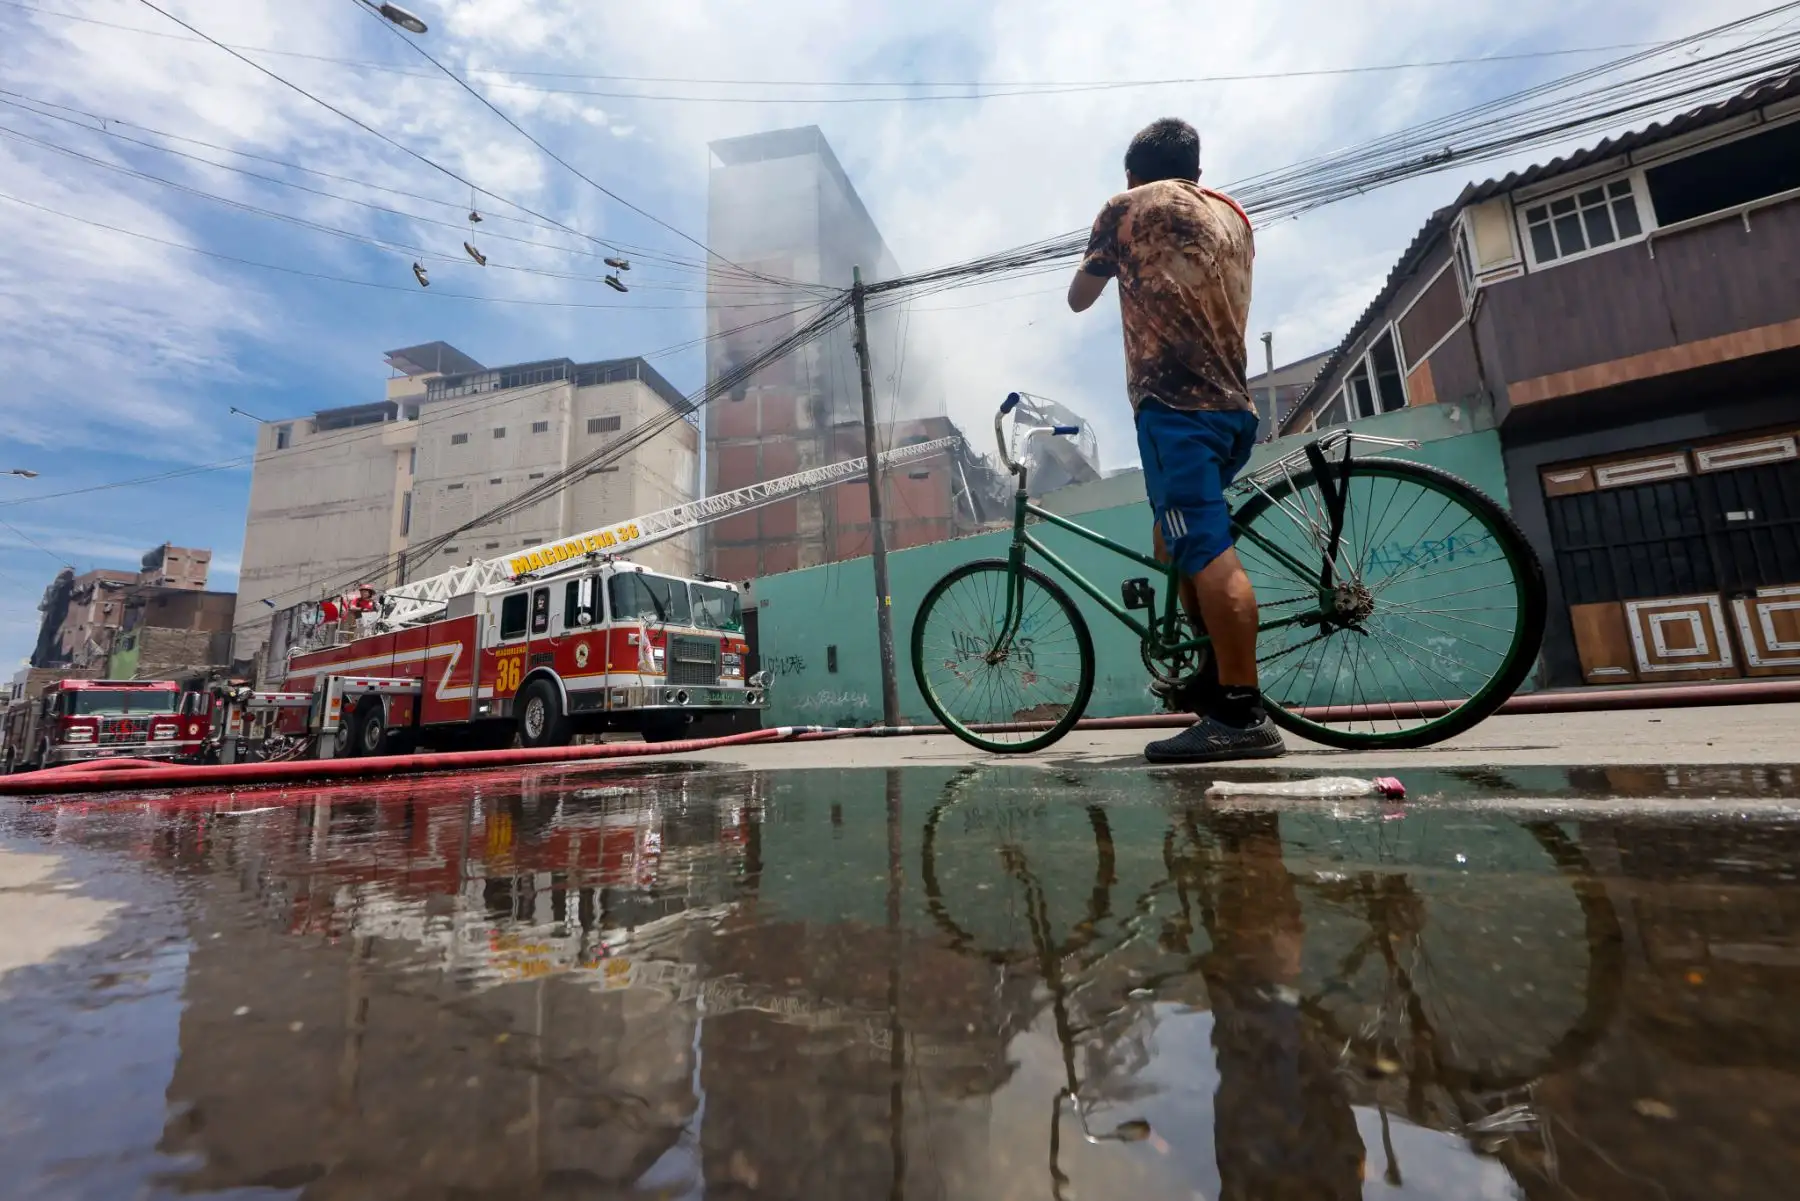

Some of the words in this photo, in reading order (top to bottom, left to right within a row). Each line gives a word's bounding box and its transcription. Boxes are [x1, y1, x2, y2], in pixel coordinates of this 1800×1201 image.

[510, 531, 617, 575] MAGDALENA
[616, 523, 640, 542] 36
[496, 657, 521, 692] 36
